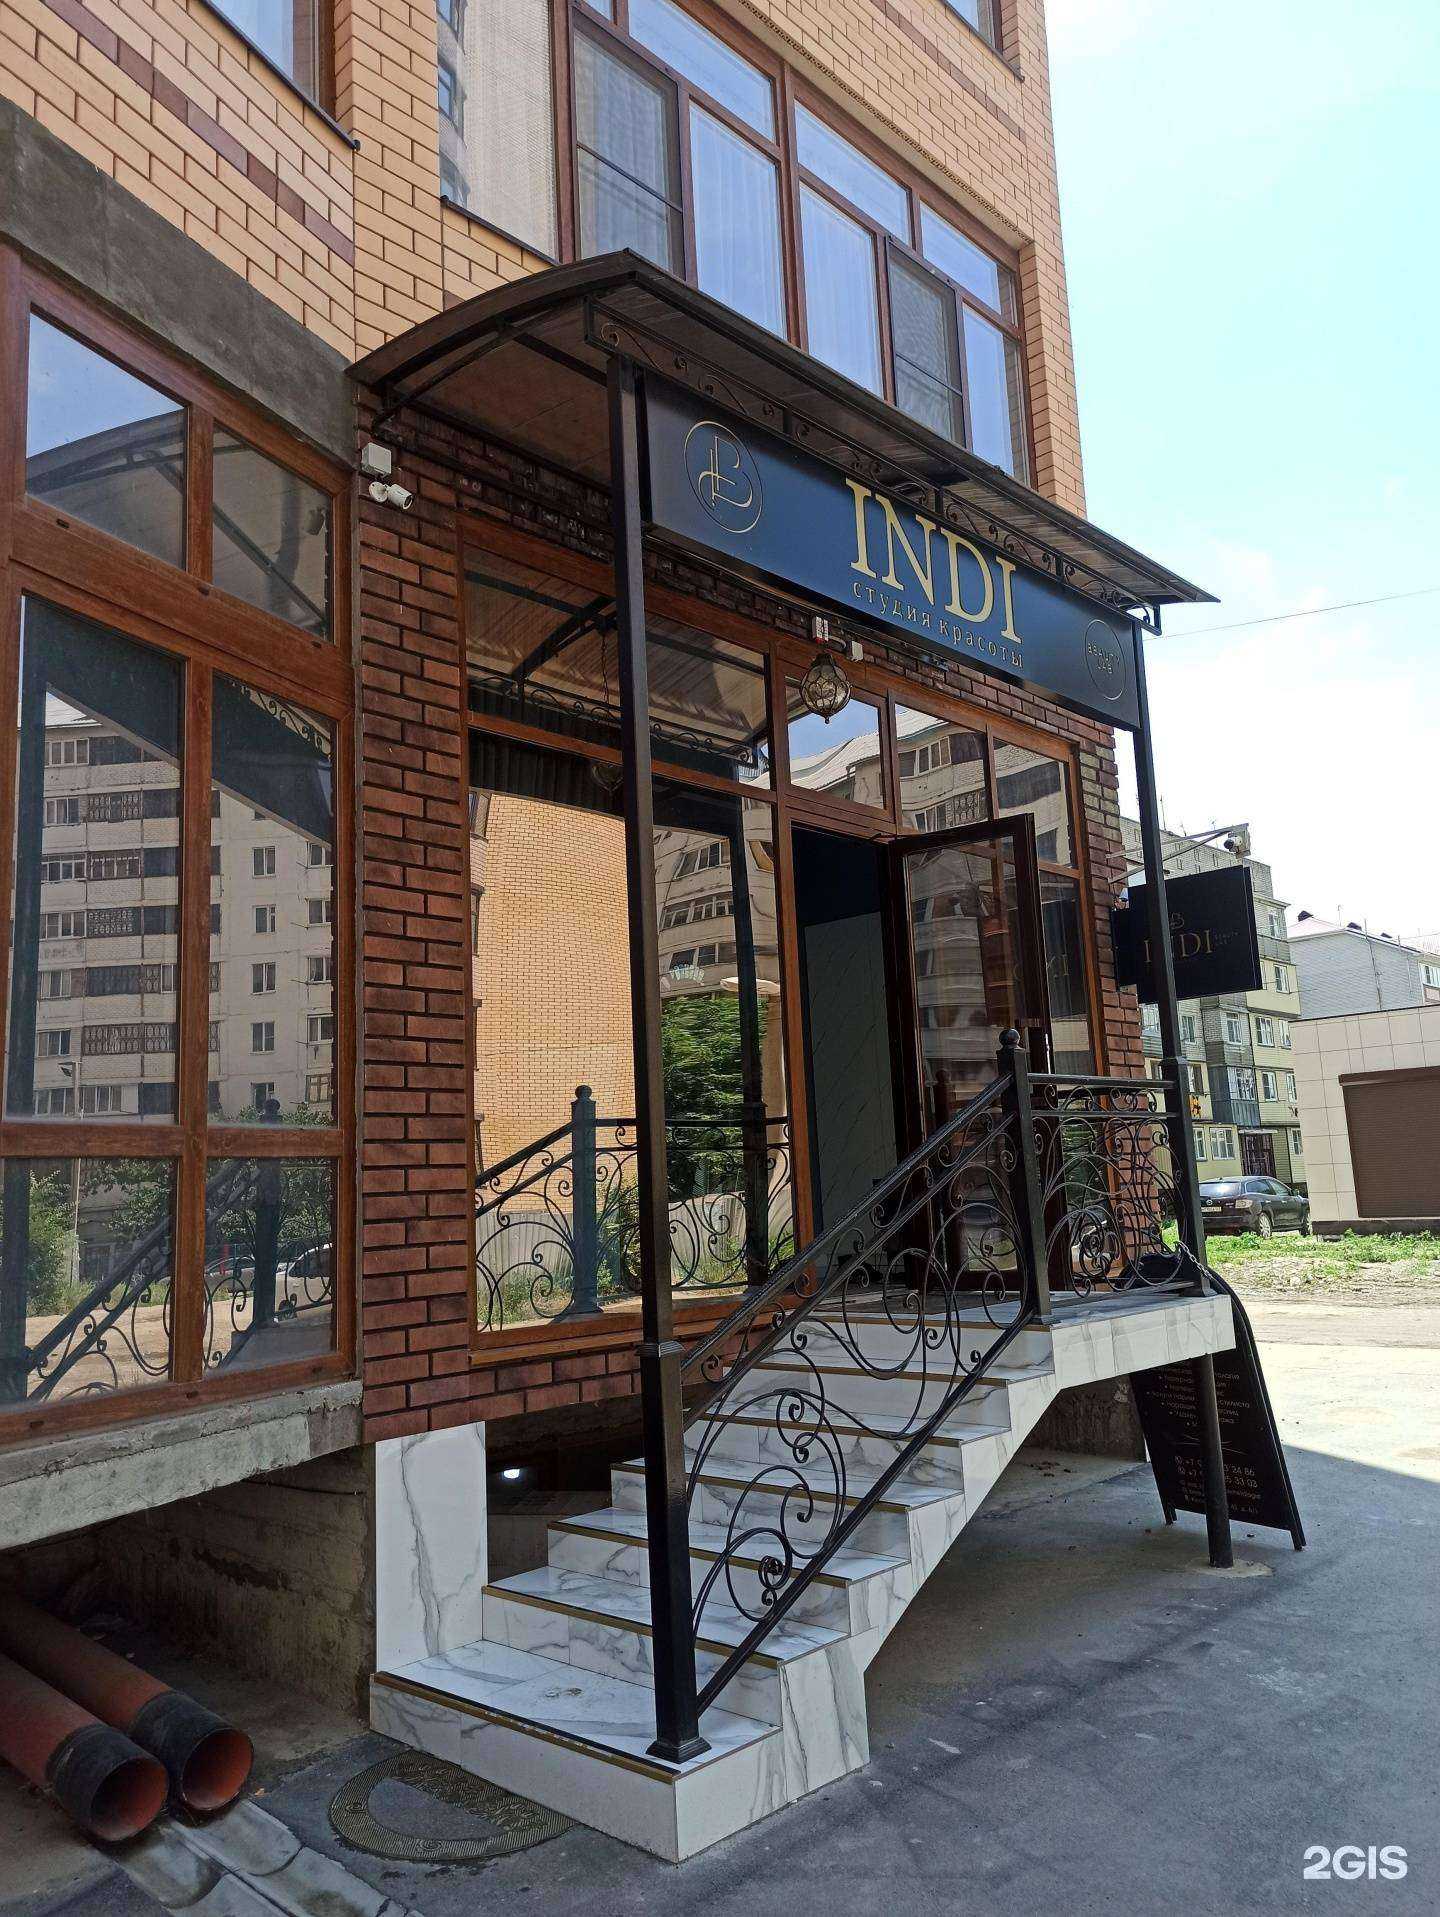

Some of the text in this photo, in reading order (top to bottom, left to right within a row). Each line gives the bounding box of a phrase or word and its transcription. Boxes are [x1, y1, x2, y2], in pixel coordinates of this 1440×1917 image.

[846, 478, 1022, 644] INDI
[853, 582, 1023, 669] студия красоты
[1143, 930, 1213, 963] IDI
